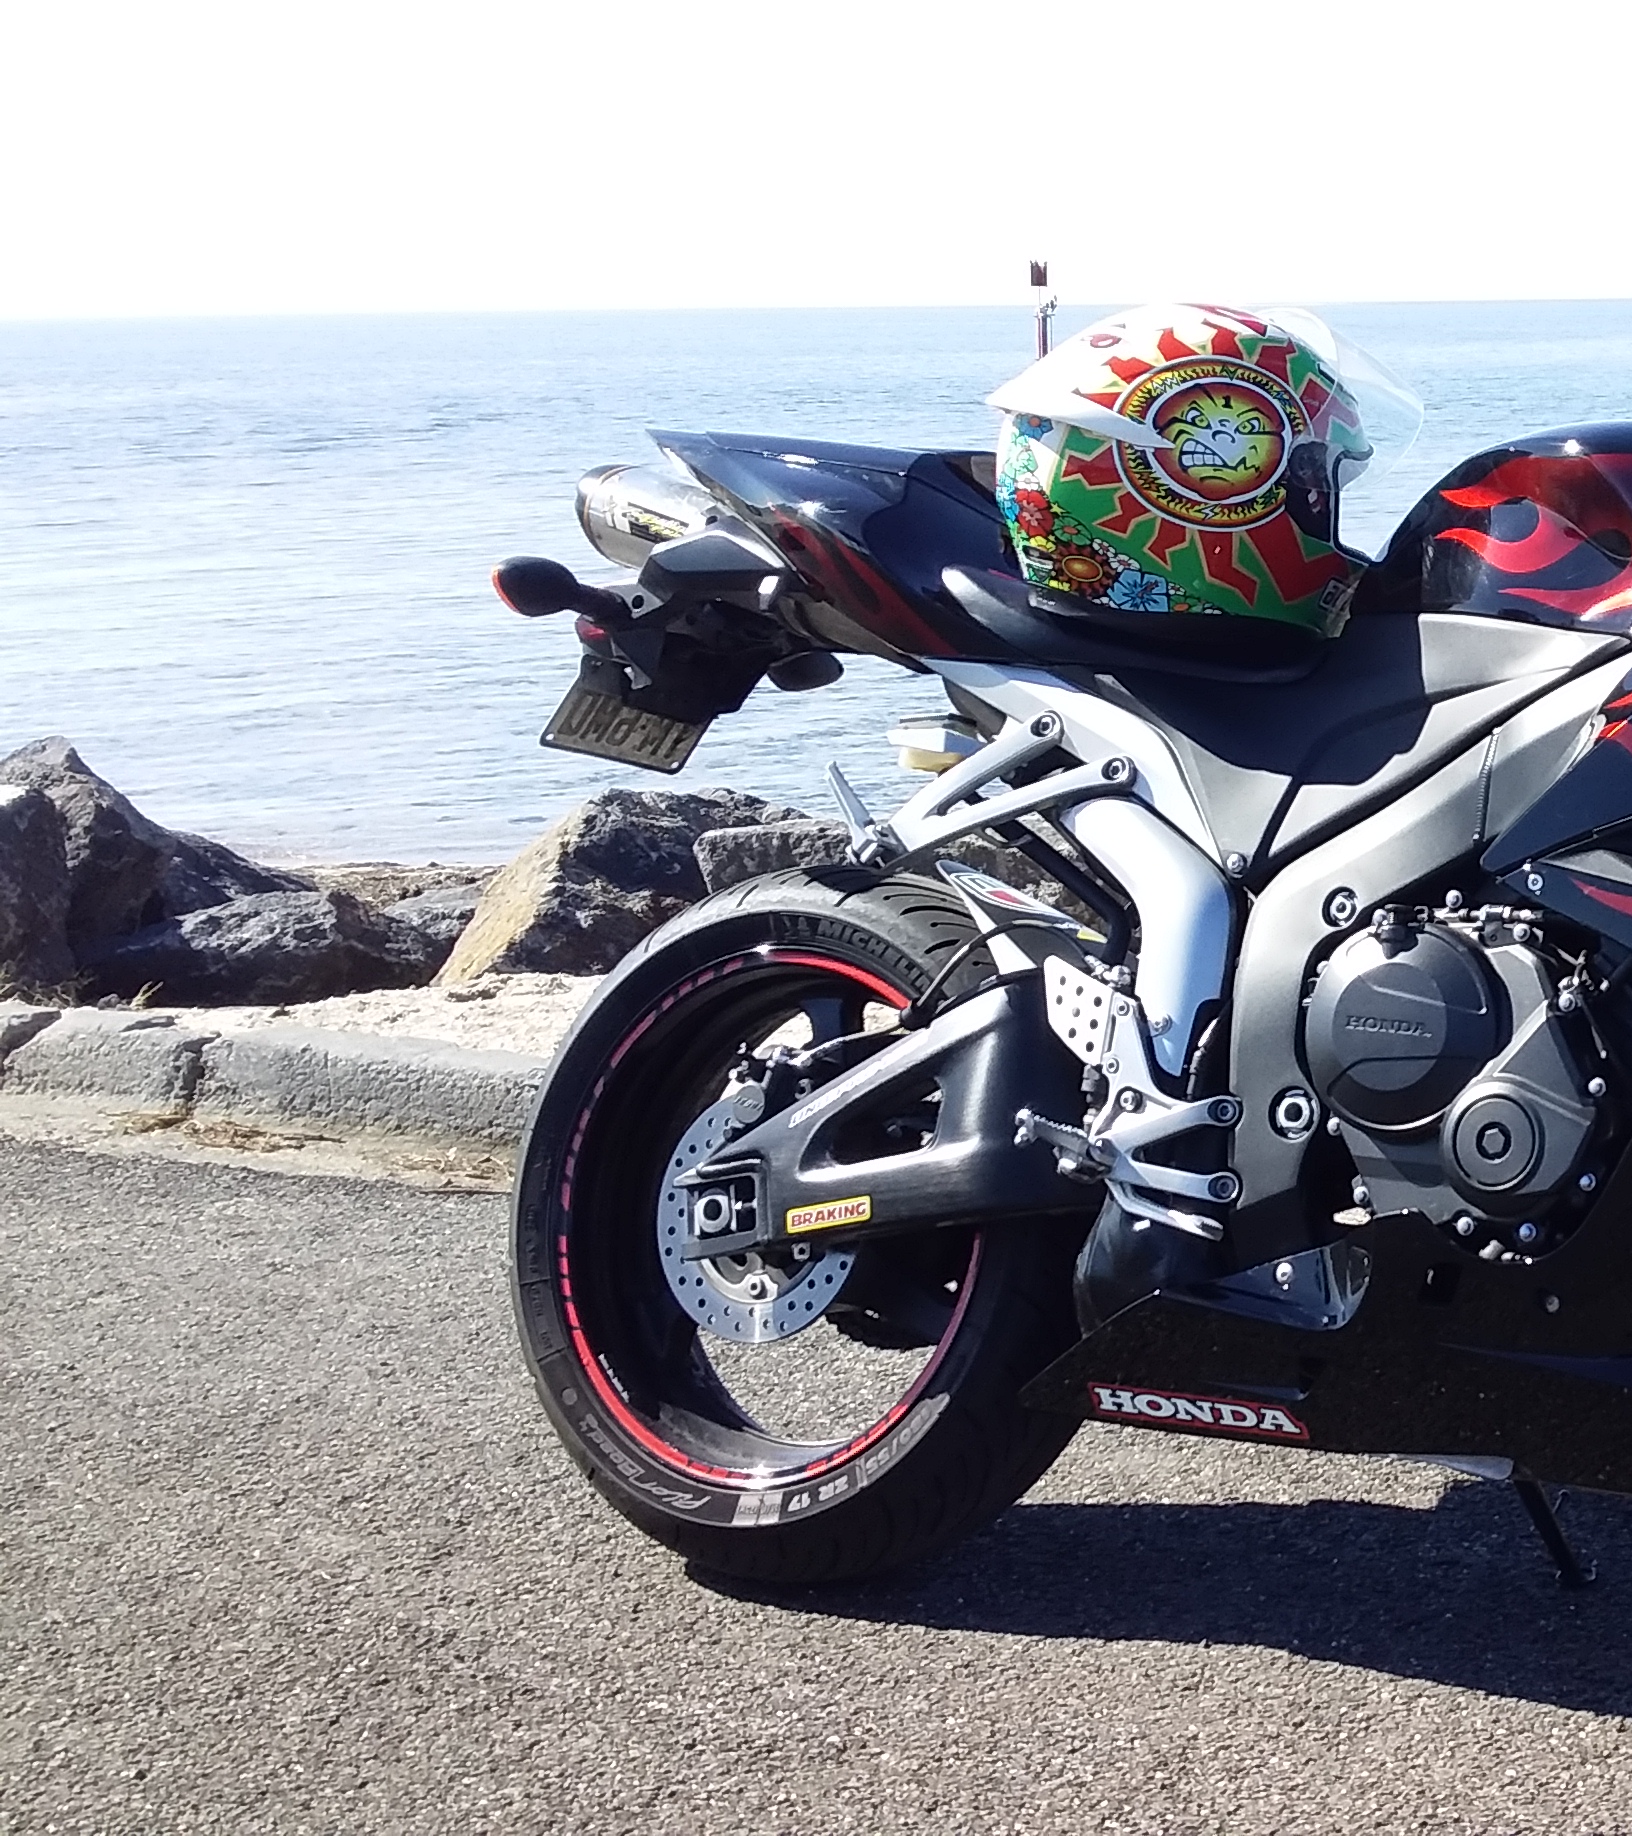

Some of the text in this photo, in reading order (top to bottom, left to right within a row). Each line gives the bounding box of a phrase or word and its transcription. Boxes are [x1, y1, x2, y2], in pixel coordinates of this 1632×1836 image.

[816, 917, 931, 992] MICHELIN
[1344, 1014, 1433, 1039] HONDA
[790, 1200, 868, 1229] BRAKING
[1093, 1387, 1301, 1435] HONDA
[787, 1491, 811, 1513] 17
